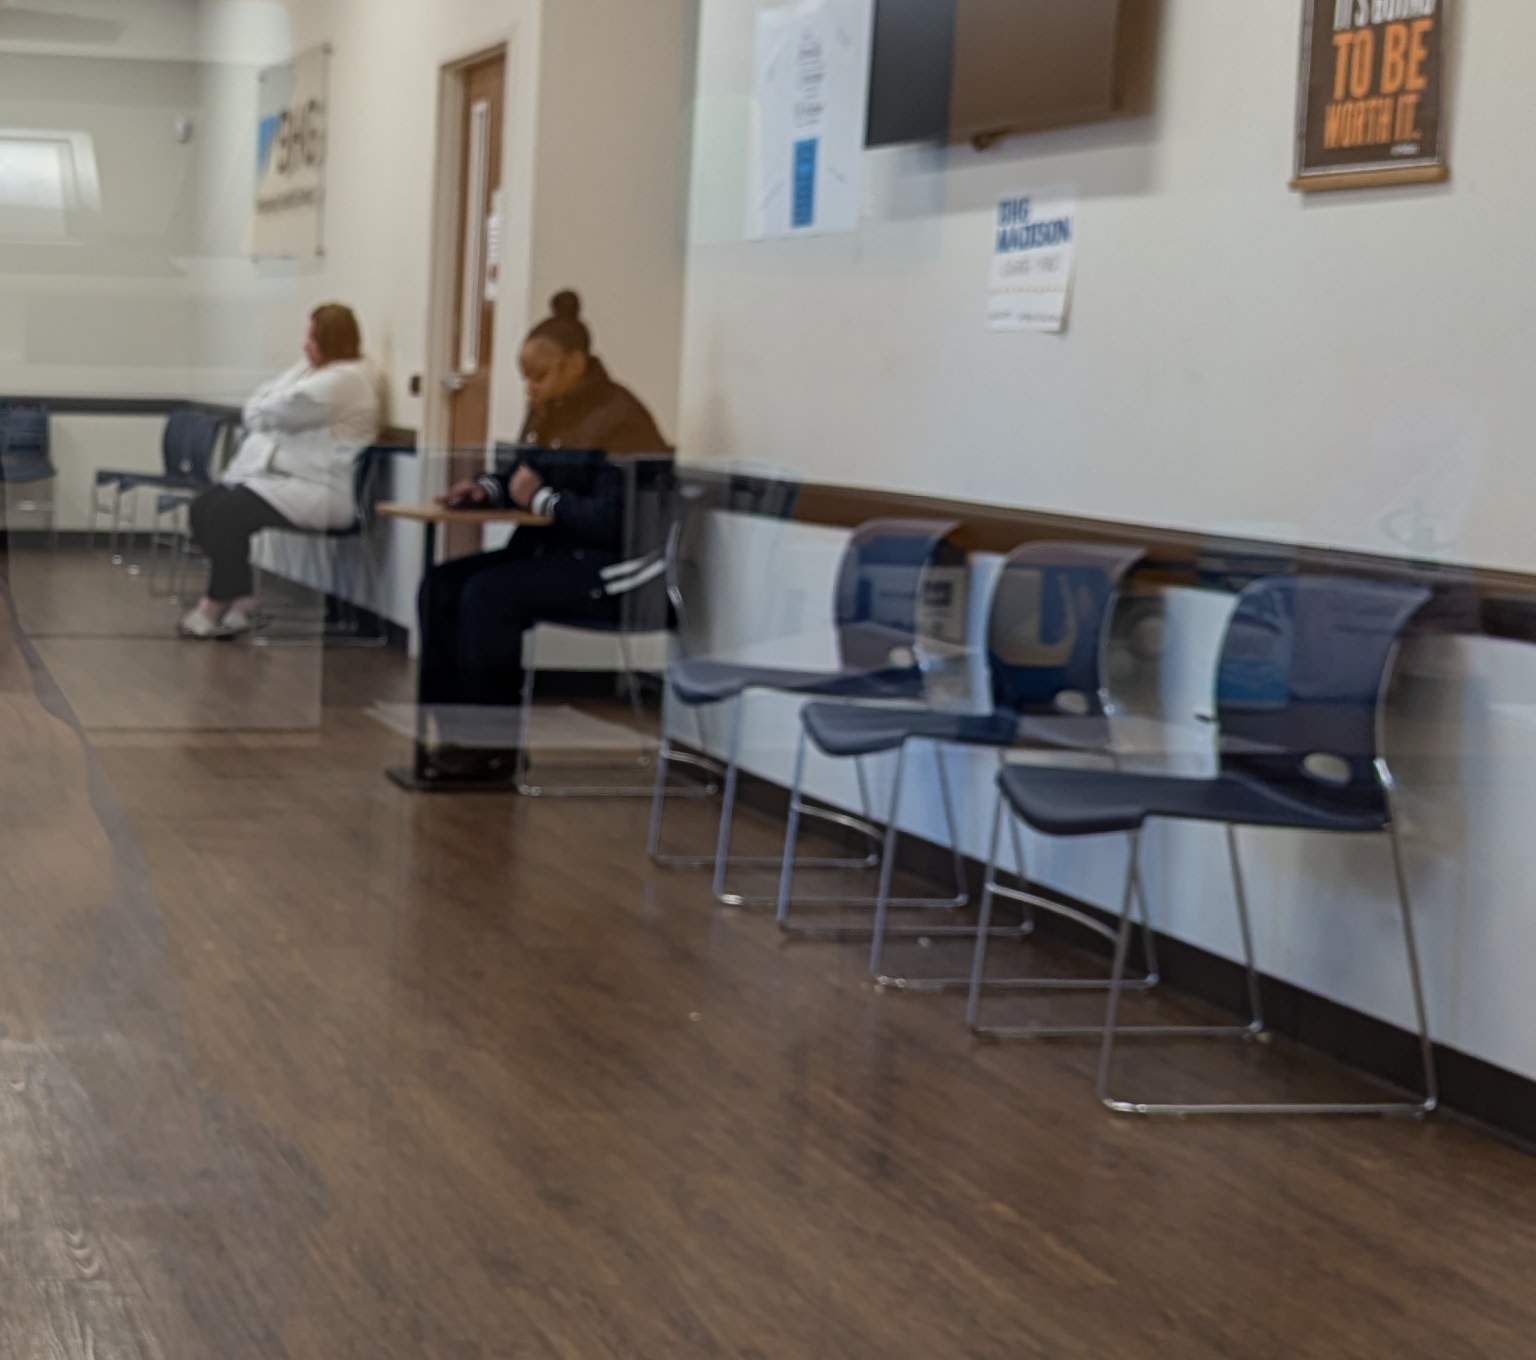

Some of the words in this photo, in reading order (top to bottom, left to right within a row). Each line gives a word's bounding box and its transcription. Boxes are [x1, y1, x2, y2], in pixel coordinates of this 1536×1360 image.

[1333, 27, 1373, 100] TO
[1381, 19, 1433, 92] BE
[1324, 98, 1393, 148] WORTH
